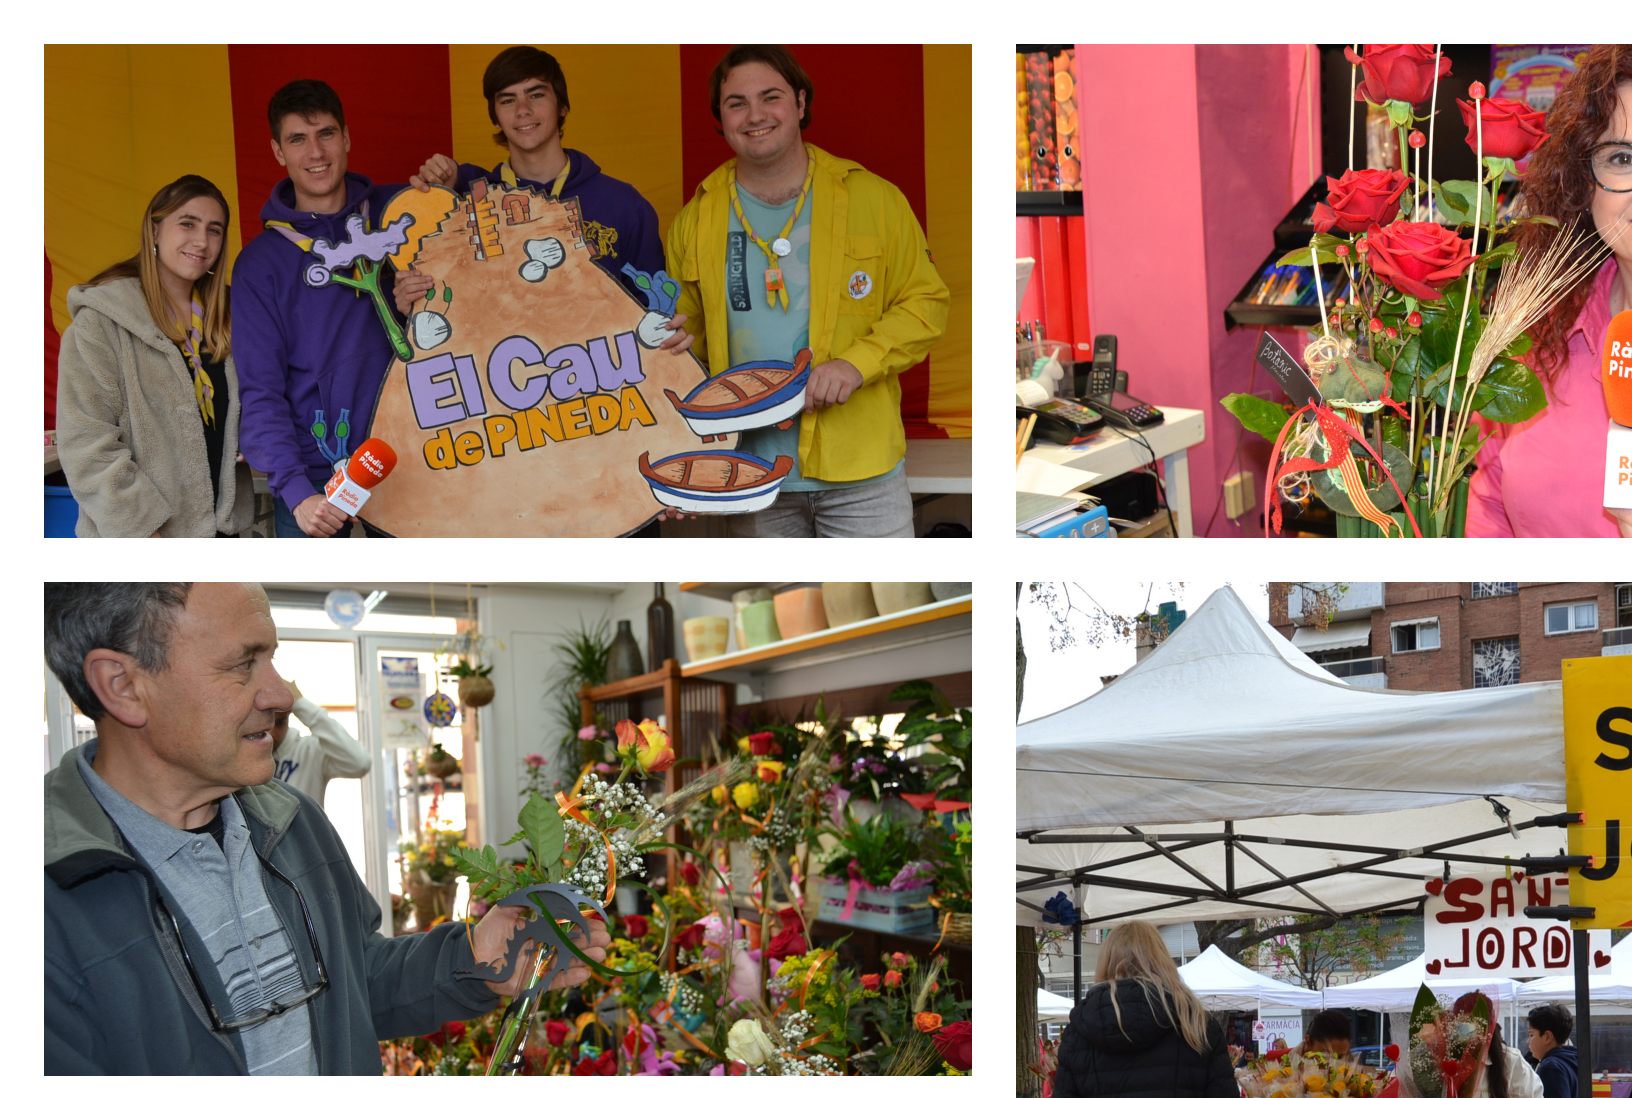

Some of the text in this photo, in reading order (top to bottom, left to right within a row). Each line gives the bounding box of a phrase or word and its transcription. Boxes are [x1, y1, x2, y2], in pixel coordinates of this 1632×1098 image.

[731, 234, 746, 308] SPRINGFIELD
[406, 331, 646, 429] El Cau
[423, 385, 658, 470] de PINEDA
[359, 456, 383, 477] Pineda
[363, 450, 385, 470] Ràdio
[339, 493, 358, 508] Pineda
[1436, 877, 1568, 924] SAN
[1444, 925, 1590, 969] JORD
[1263, 1019, 1300, 1030] ARMÀCIA
